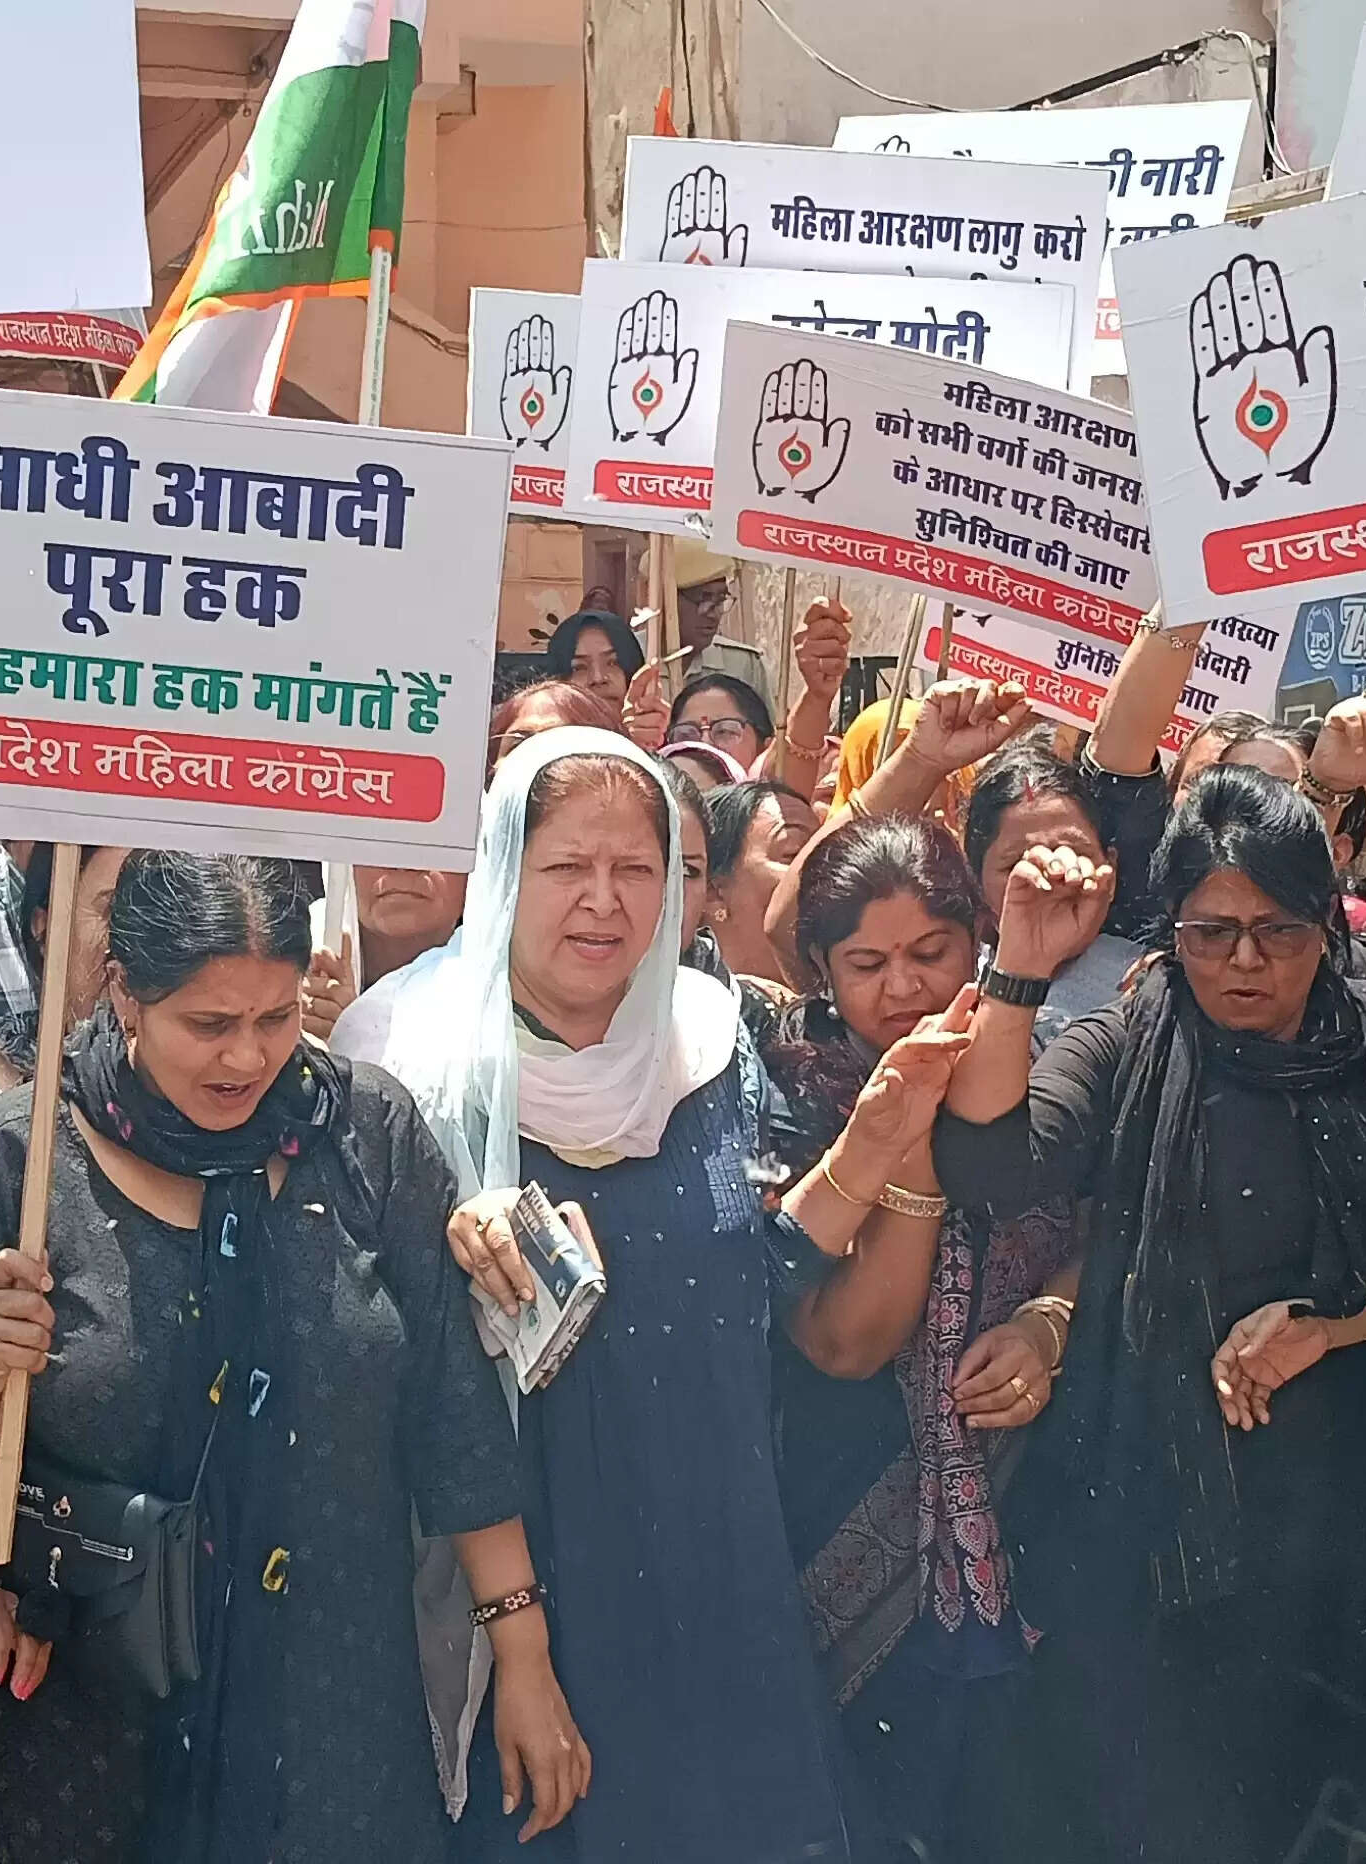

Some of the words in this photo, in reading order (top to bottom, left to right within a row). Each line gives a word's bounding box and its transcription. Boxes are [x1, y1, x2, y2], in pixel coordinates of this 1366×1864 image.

[1140, 145, 1225, 197] नारी
[770, 195, 855, 243] महिला
[858, 209, 965, 252] आरक्षण
[968, 218, 1024, 270] लागु
[1034, 215, 1086, 262] करो
[875, 409, 914, 439] को
[918, 421, 974, 454] सभी
[1033, 448, 1069, 480] की
[944, 381, 1031, 423] महिला
[1034, 404, 1138, 458] आरक्षण
[154, 461, 414, 550] आबादी
[616, 471, 715, 500] राजस्था
[893, 455, 920, 484] के
[926, 467, 1006, 508] आधार
[1012, 489, 1046, 520] पर
[1051, 495, 1151, 555] हिस्सेदार
[44, 543, 173, 635] पूरा
[182, 555, 307, 628] हक
[763, 523, 886, 566] राजस्थान
[894, 545, 957, 583] प्रदेश
[963, 565, 1044, 607] महिला
[1051, 588, 1135, 637] कांग्रेस
[1035, 540, 1072, 572] की
[1075, 554, 1130, 590] जाए
[1310, 631, 1330, 649] ZPS
[152, 662, 243, 714] हक
[254, 661, 401, 730] मांगते
[403, 672, 452, 733] हैं
[1035, 671, 1084, 706] प्रदेश
[93, 737, 233, 790] महिला
[247, 749, 395, 804] कांग्रेस
[18, 1482, 45, 1501] OVE
